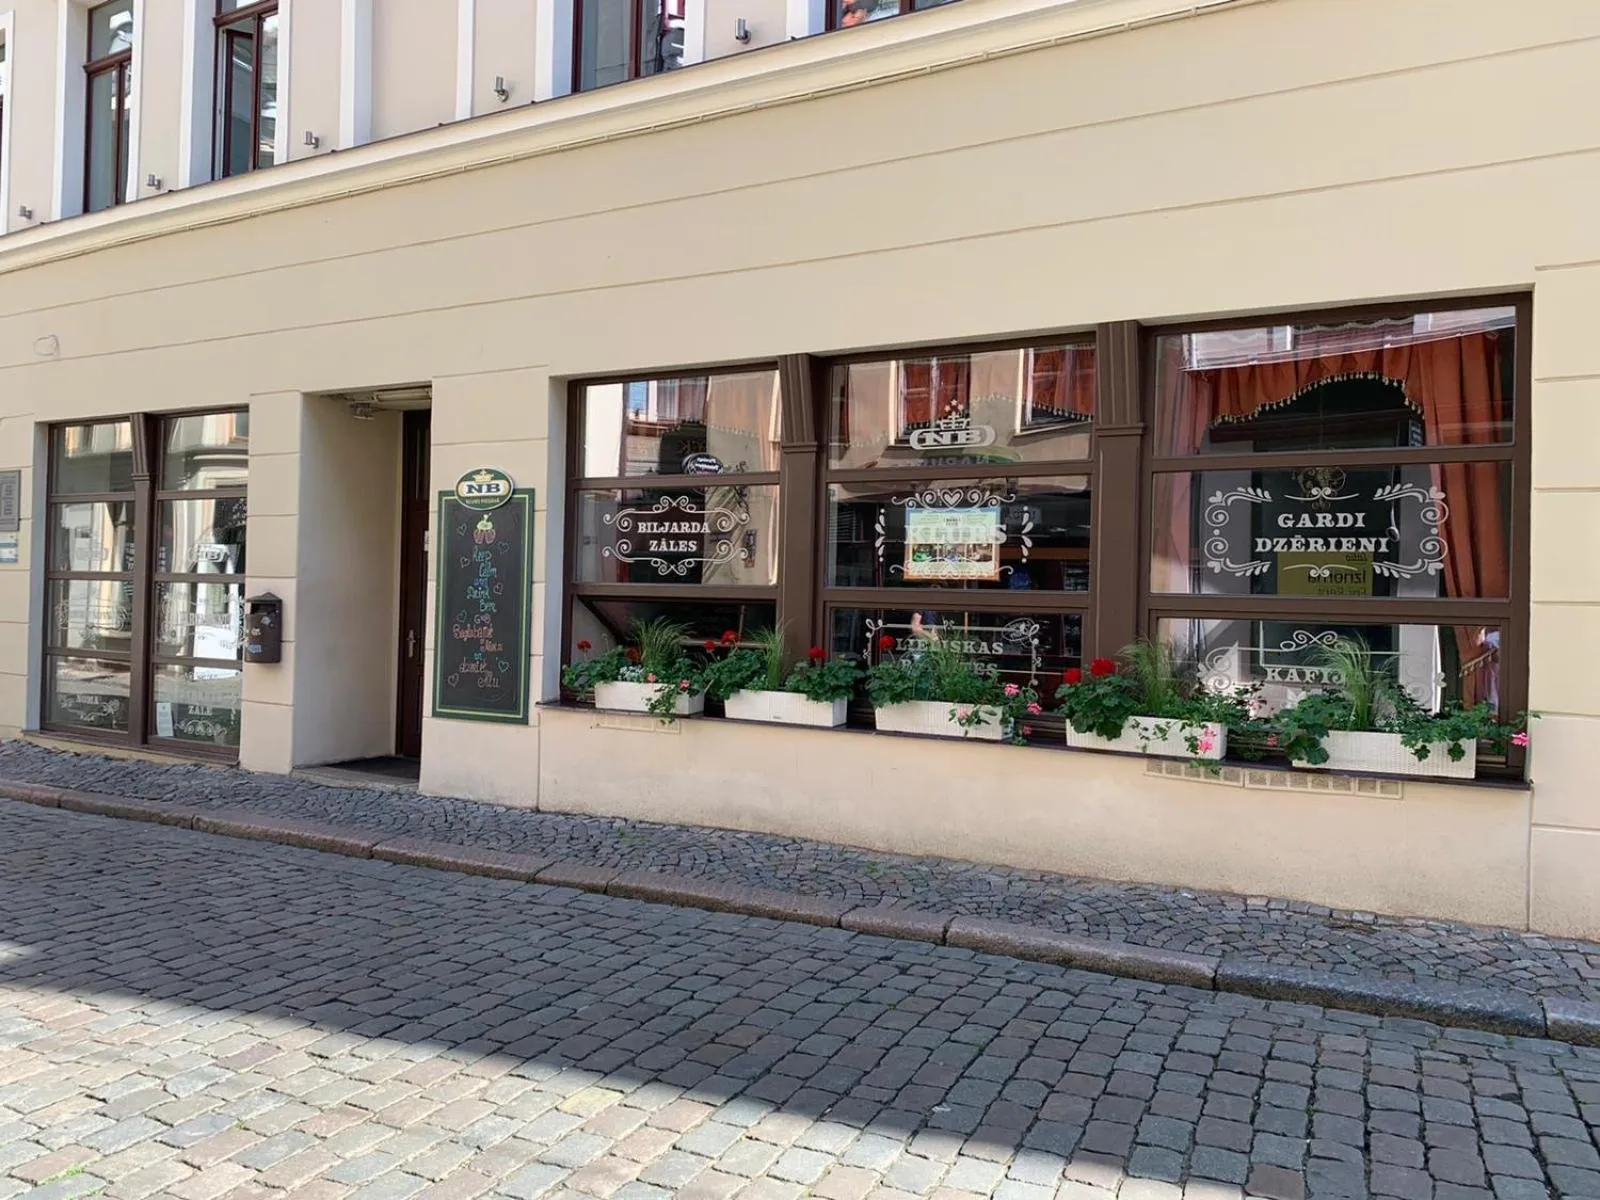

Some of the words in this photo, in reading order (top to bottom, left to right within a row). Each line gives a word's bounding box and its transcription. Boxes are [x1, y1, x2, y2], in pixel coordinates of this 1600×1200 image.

[923, 431, 982, 445] NB
[466, 483, 501, 494] NB
[637, 522, 711, 533] BILJARDA
[1277, 512, 1366, 528] GARDI
[1254, 534, 1390, 553] DZĒRIENI
[1265, 668, 1350, 685] KAFIJ
